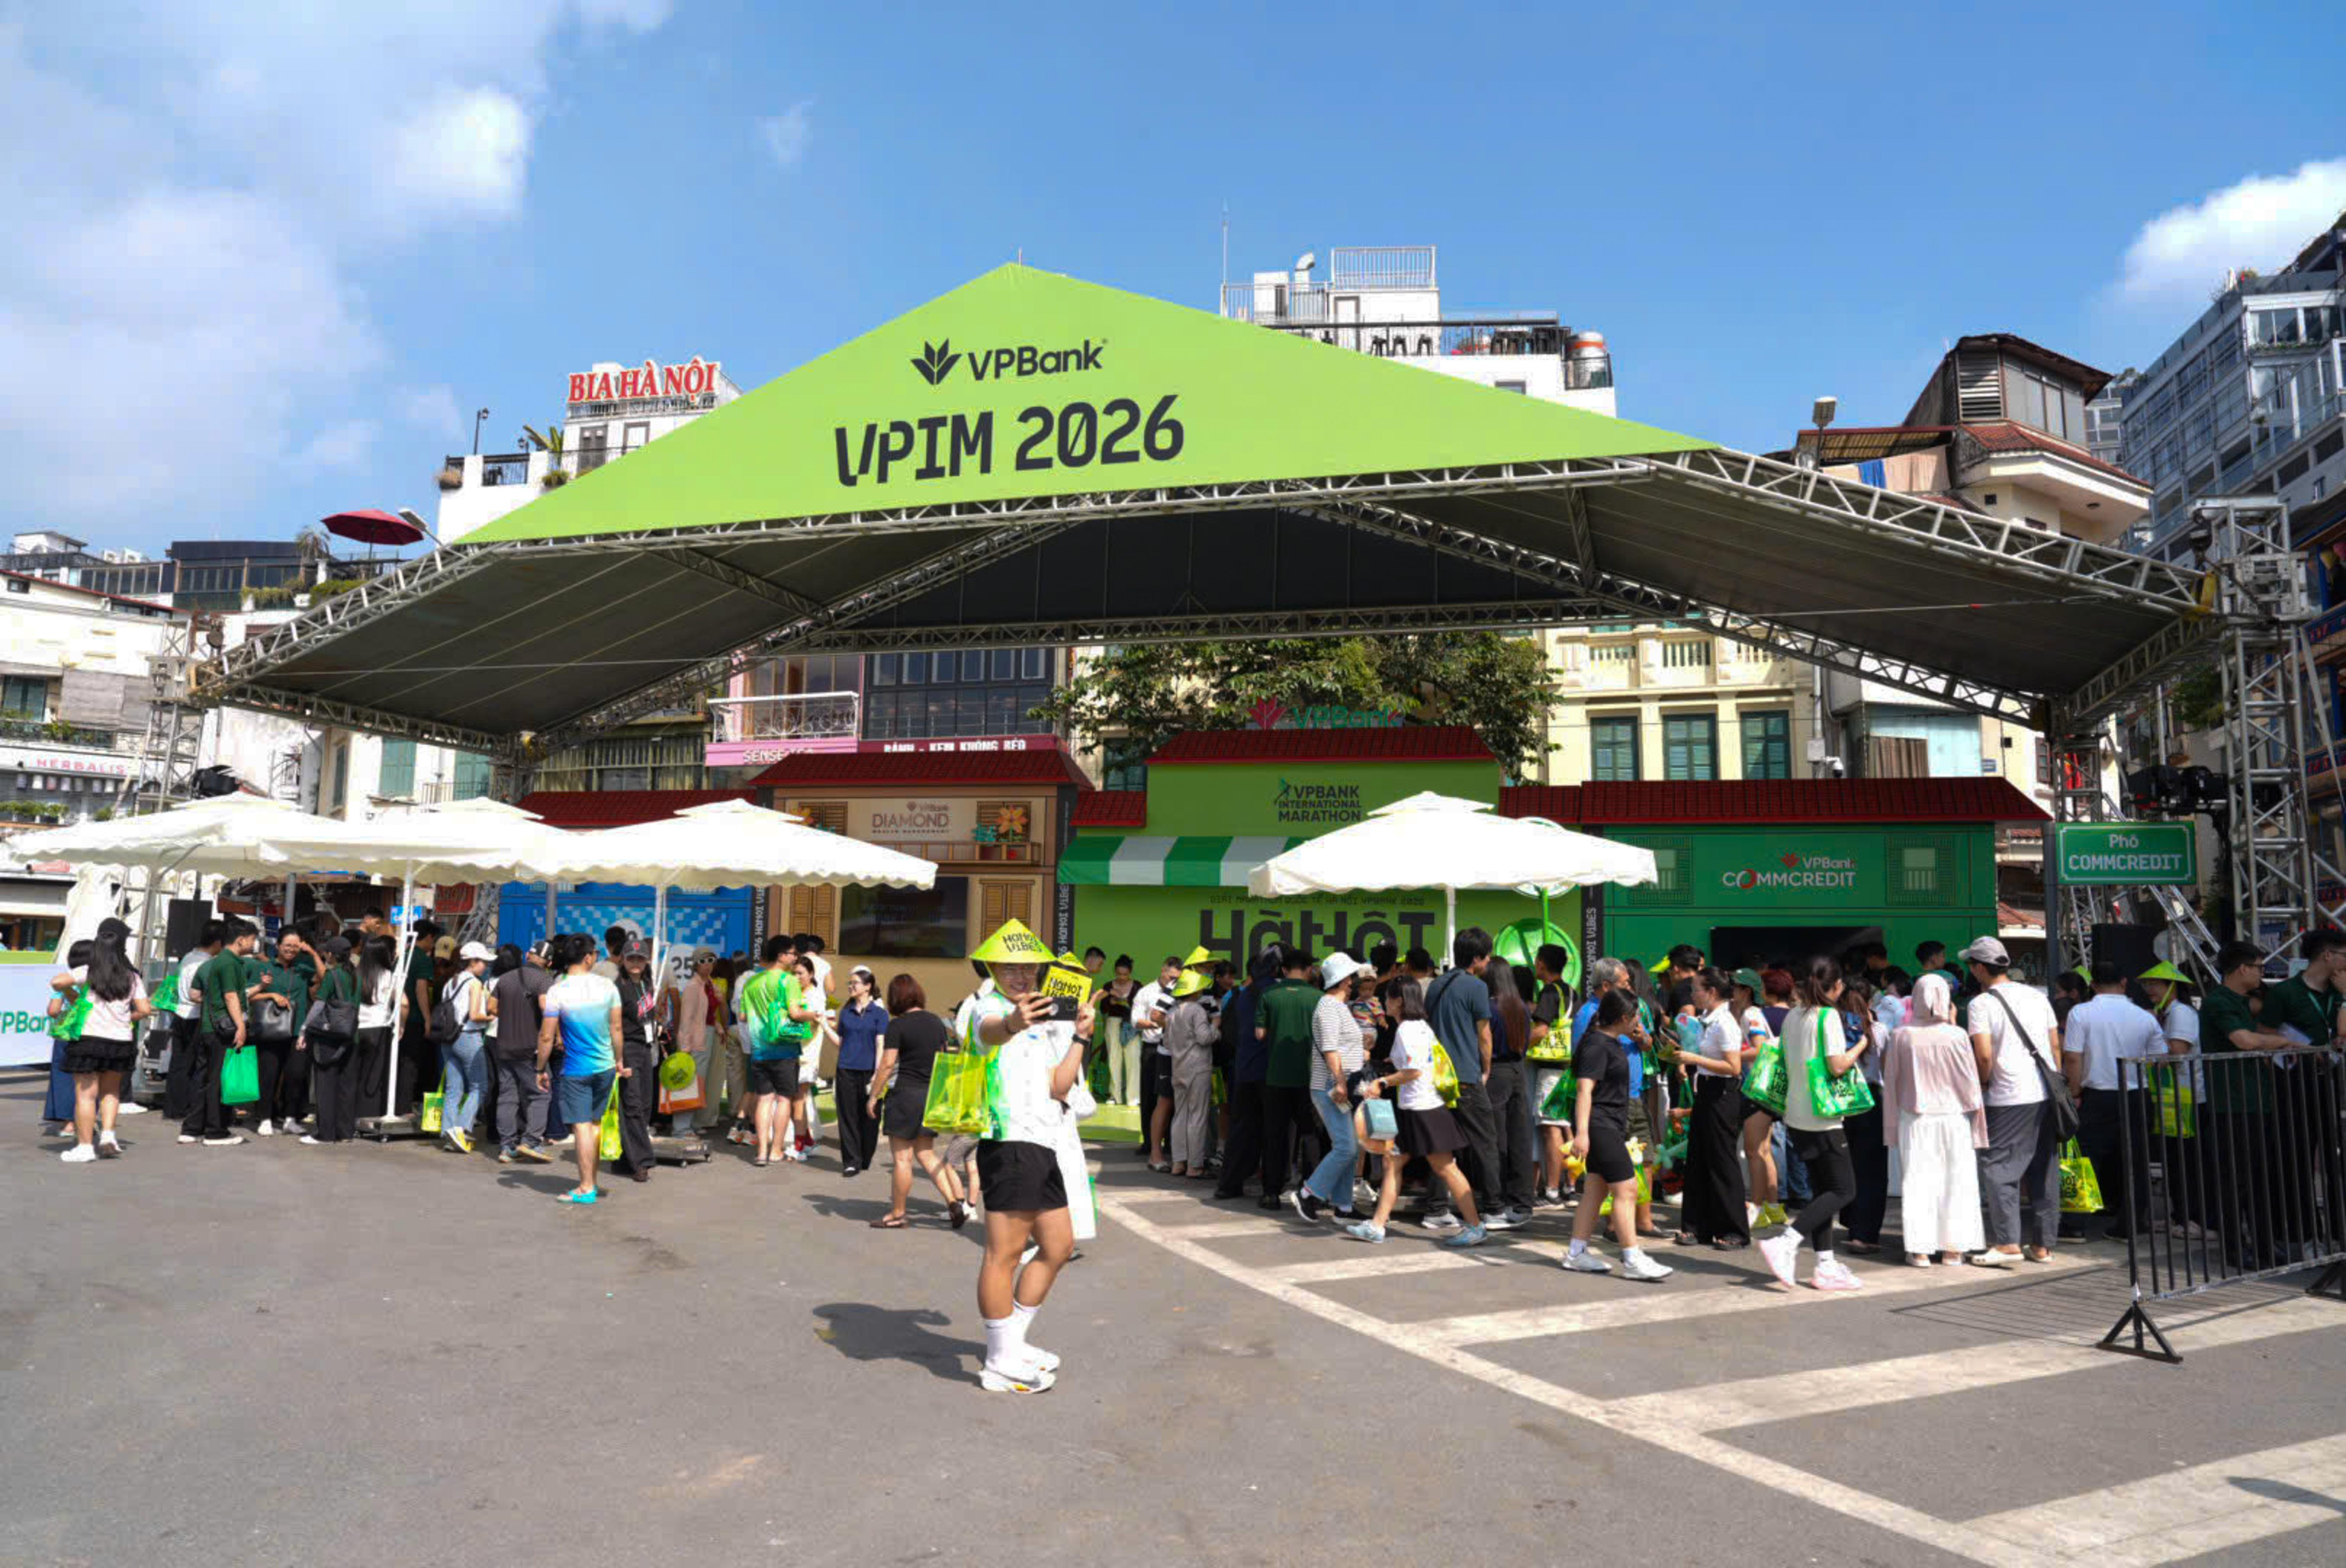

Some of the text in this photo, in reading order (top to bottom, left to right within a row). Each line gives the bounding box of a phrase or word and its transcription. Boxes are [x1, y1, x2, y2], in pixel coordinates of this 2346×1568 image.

[968, 340, 1104, 381] VPBank
[569, 358, 717, 402] BIA HÀ NỘI
[835, 394, 1185, 487] VPIM 2026
[1293, 706, 1399, 729] VPBank
[1294, 785, 1360, 799] VPBANK
[1278, 800, 1362, 809] INTERNATIONAL
[872, 813, 949, 828] DIAMOND
[1278, 810, 1361, 822] MARATHON
[1802, 857, 1855, 869] VPBank
[2069, 854, 2183, 871] COMMCREDIT
[1722, 869, 1856, 889] COMMCREDIT
[671, 957, 695, 979] 25
